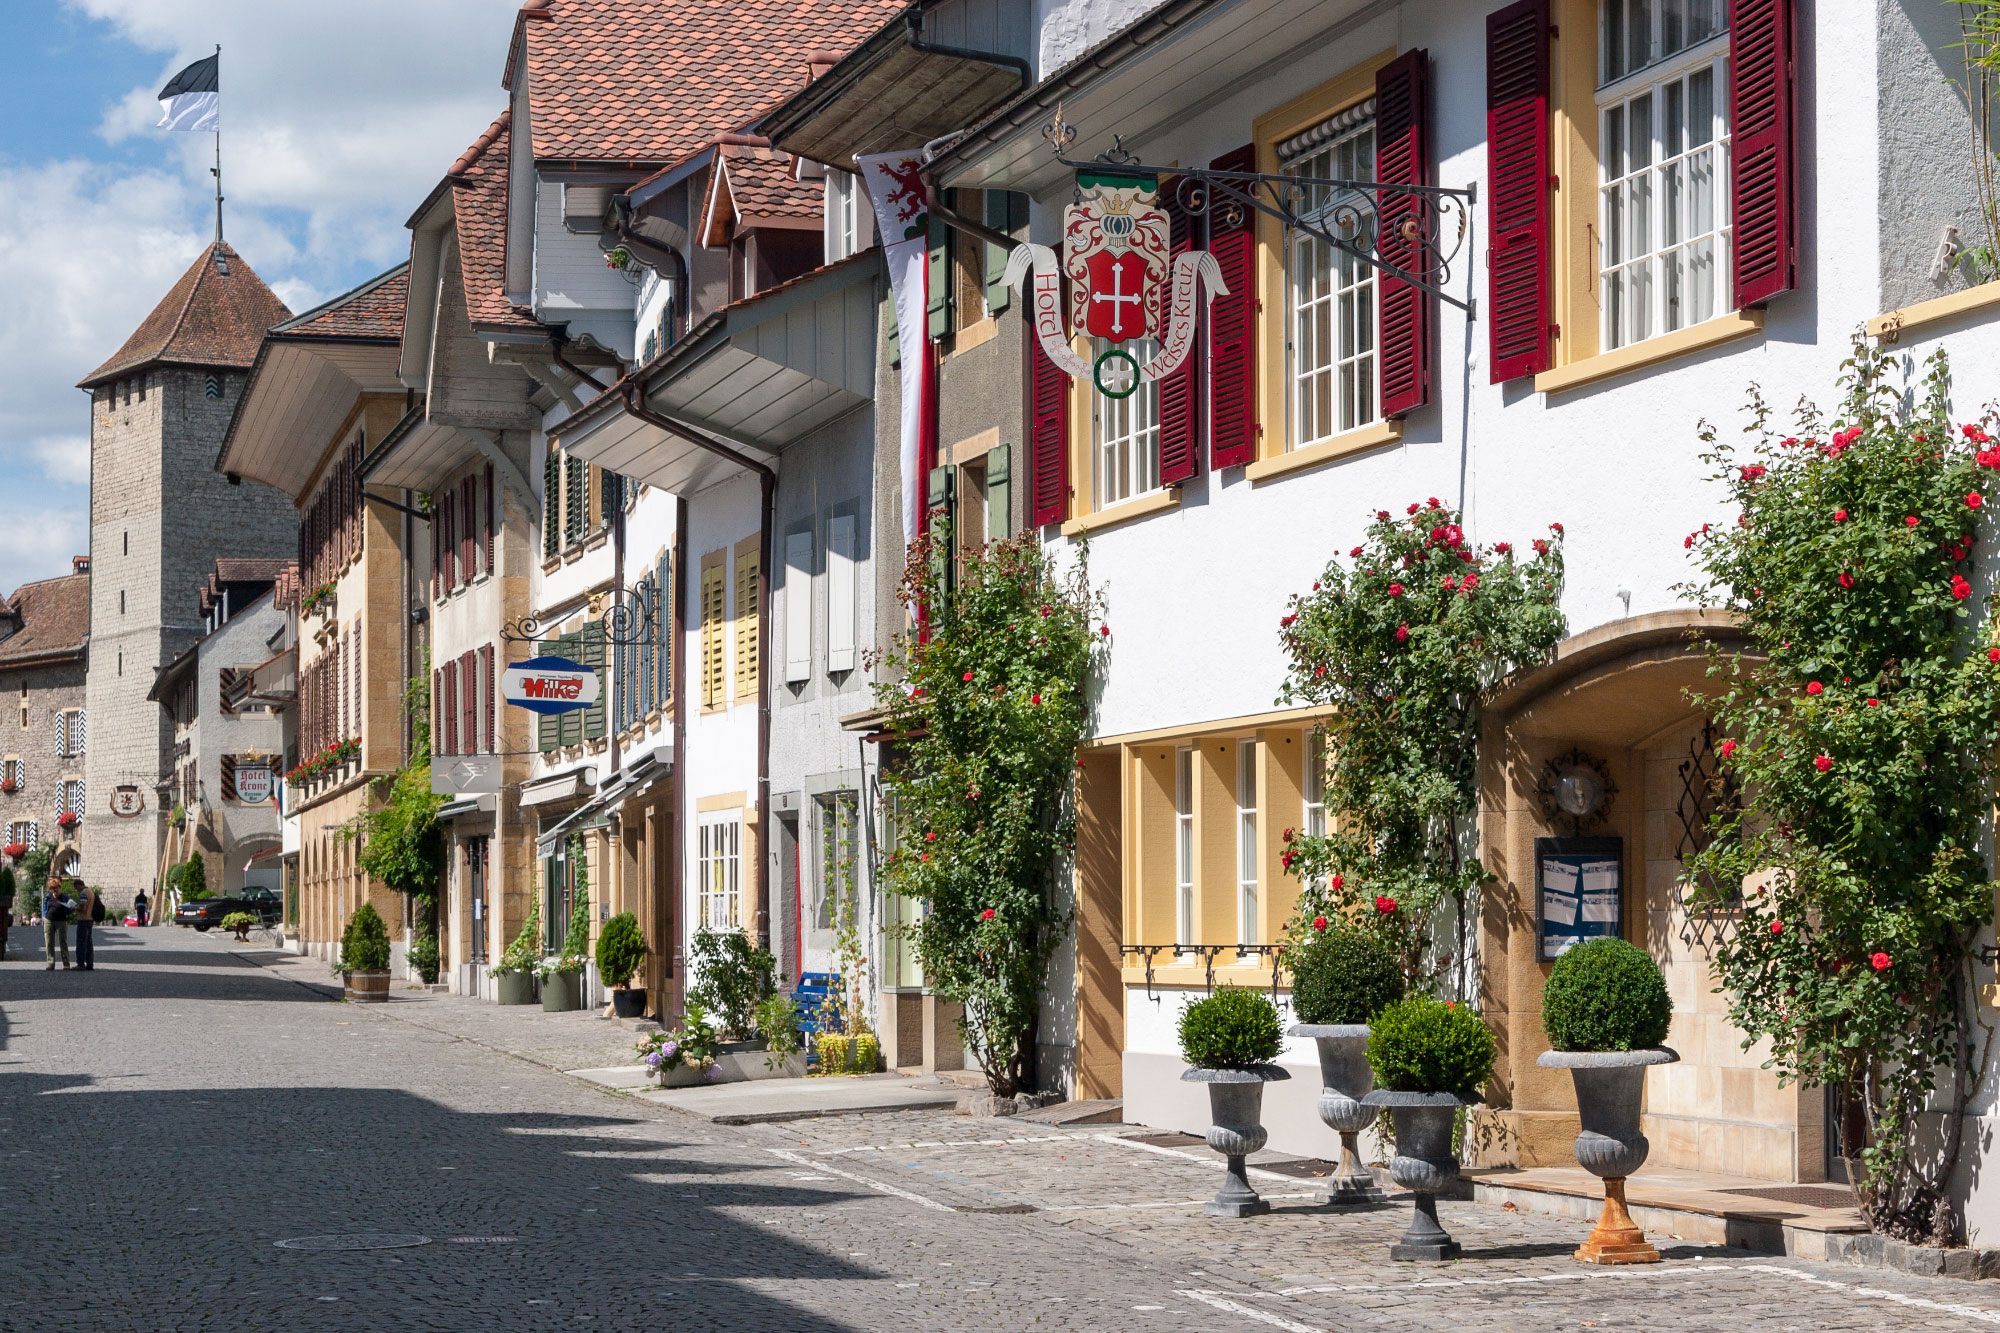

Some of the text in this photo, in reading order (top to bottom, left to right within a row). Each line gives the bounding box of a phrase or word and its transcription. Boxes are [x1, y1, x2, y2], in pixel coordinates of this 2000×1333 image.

[1036, 273, 1062, 339] Hotel
[1142, 262, 1194, 379] Weisses Kreuz
[525, 678, 580, 699] Wilke
[239, 781, 267, 791] Krone
[241, 770, 266, 781] Hotel
